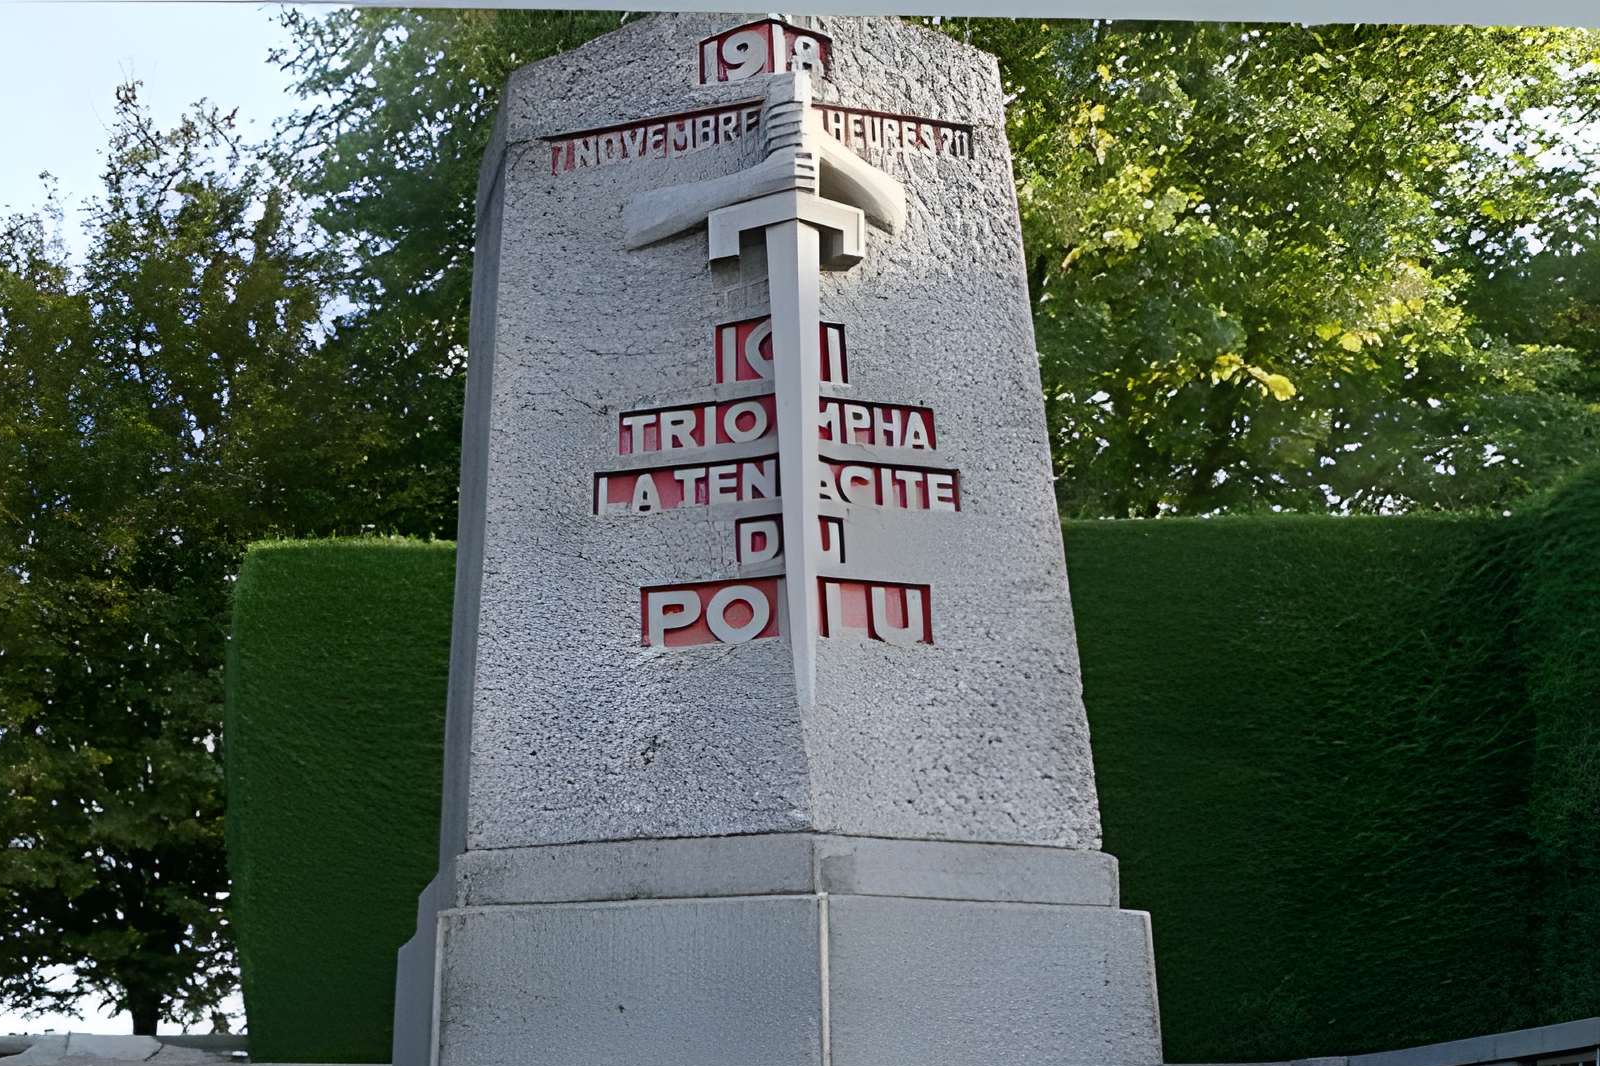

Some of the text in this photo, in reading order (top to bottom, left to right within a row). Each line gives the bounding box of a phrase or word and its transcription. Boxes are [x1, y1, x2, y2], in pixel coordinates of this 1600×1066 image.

[572, 108, 763, 170] NOVEMBRE
[828, 110, 935, 155] HEURES
[598, 474, 662, 514] LA
